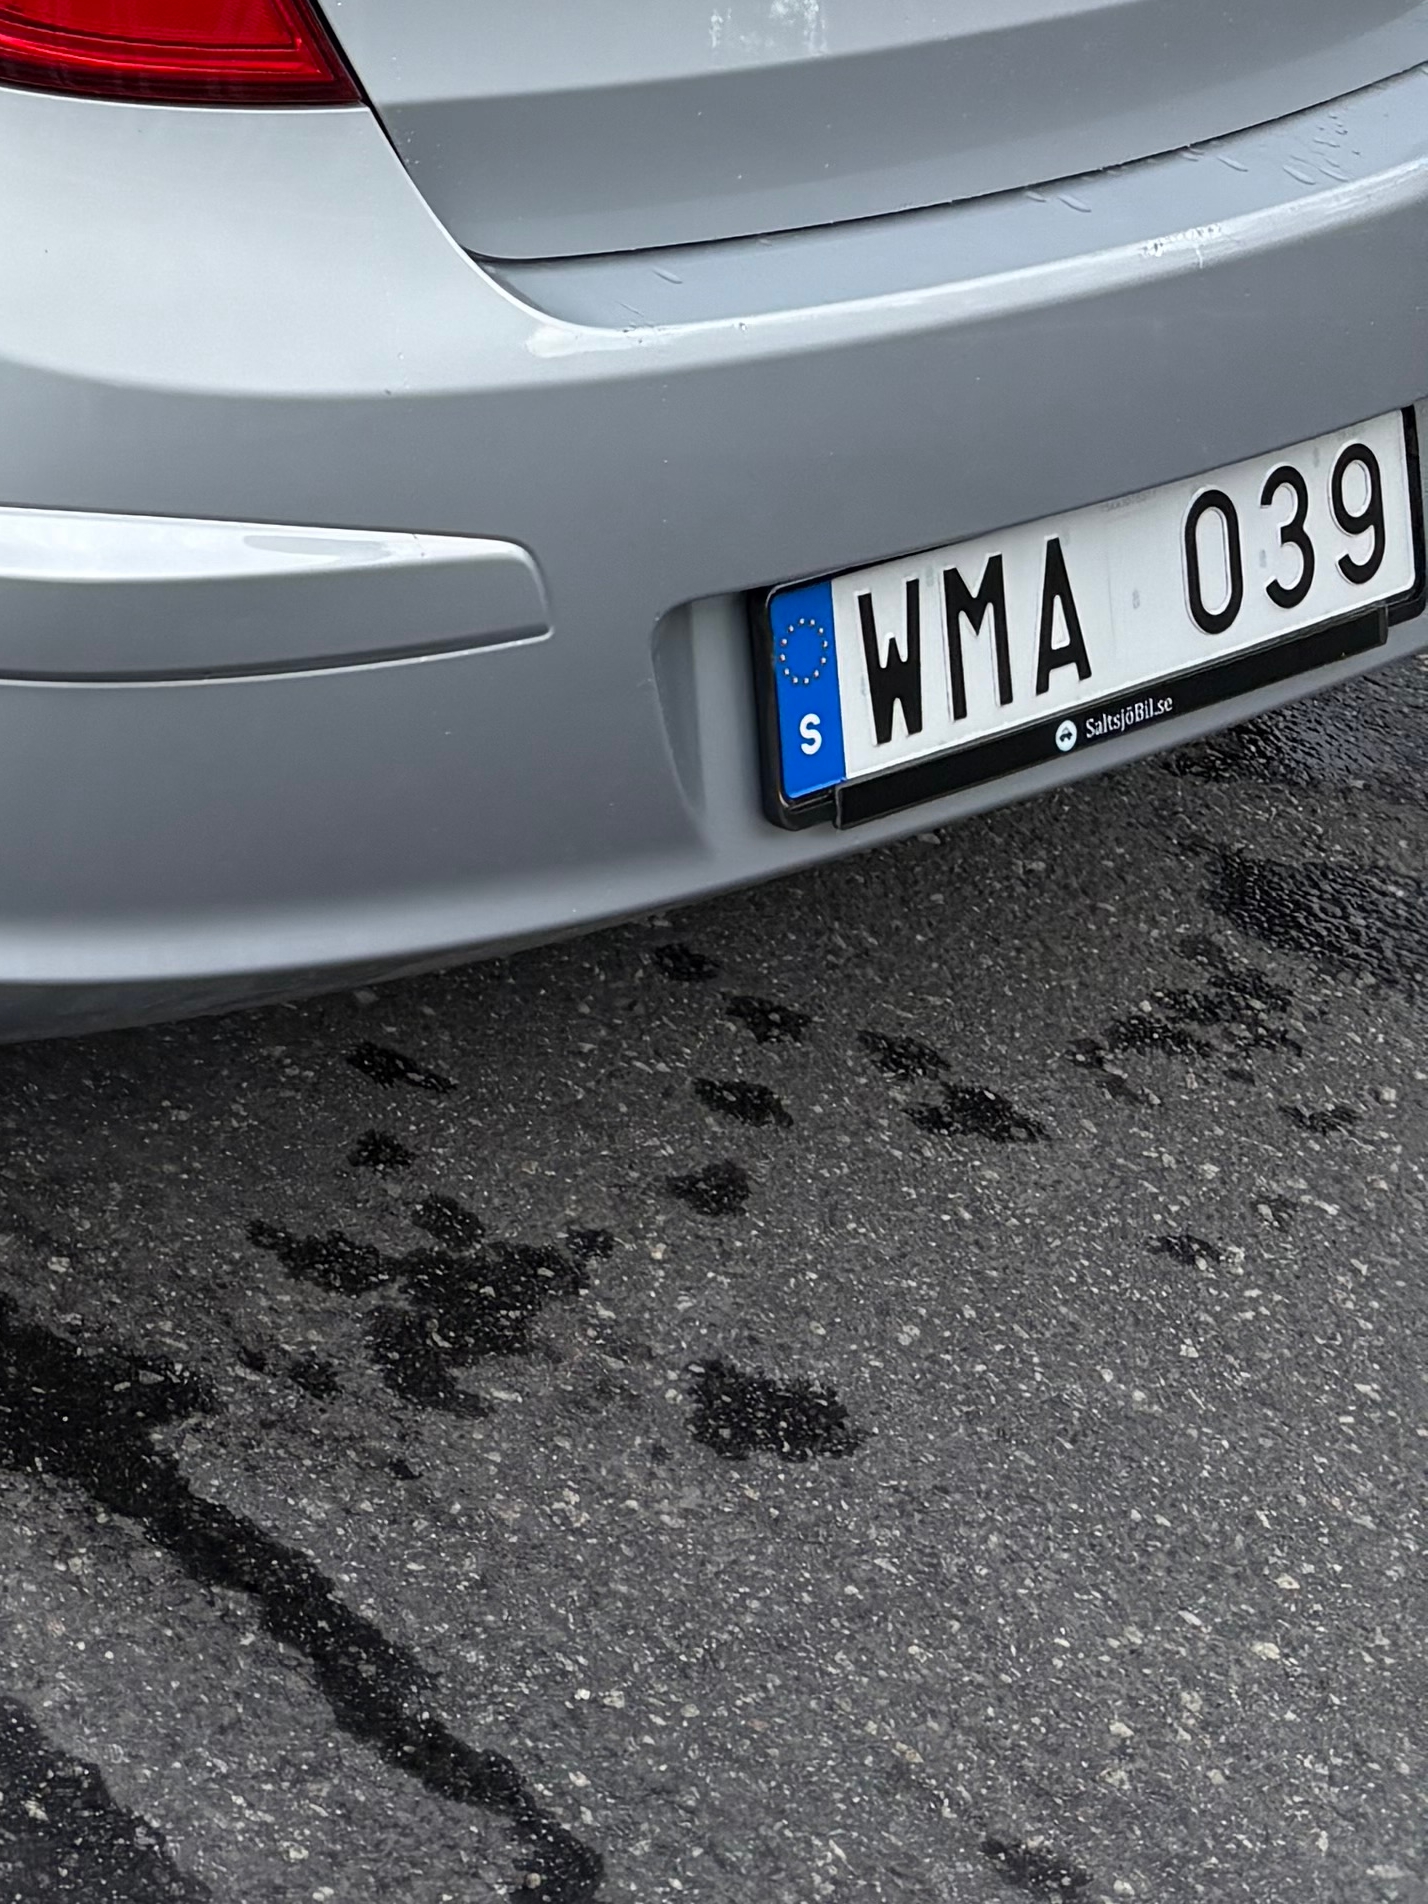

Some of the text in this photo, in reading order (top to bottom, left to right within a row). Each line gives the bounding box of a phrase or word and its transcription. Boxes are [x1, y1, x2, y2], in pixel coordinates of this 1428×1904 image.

[857, 443, 1386, 746] WMA 039
[799, 712, 822, 755] S
[1085, 696, 1174, 739] SaltsjöBil.se
